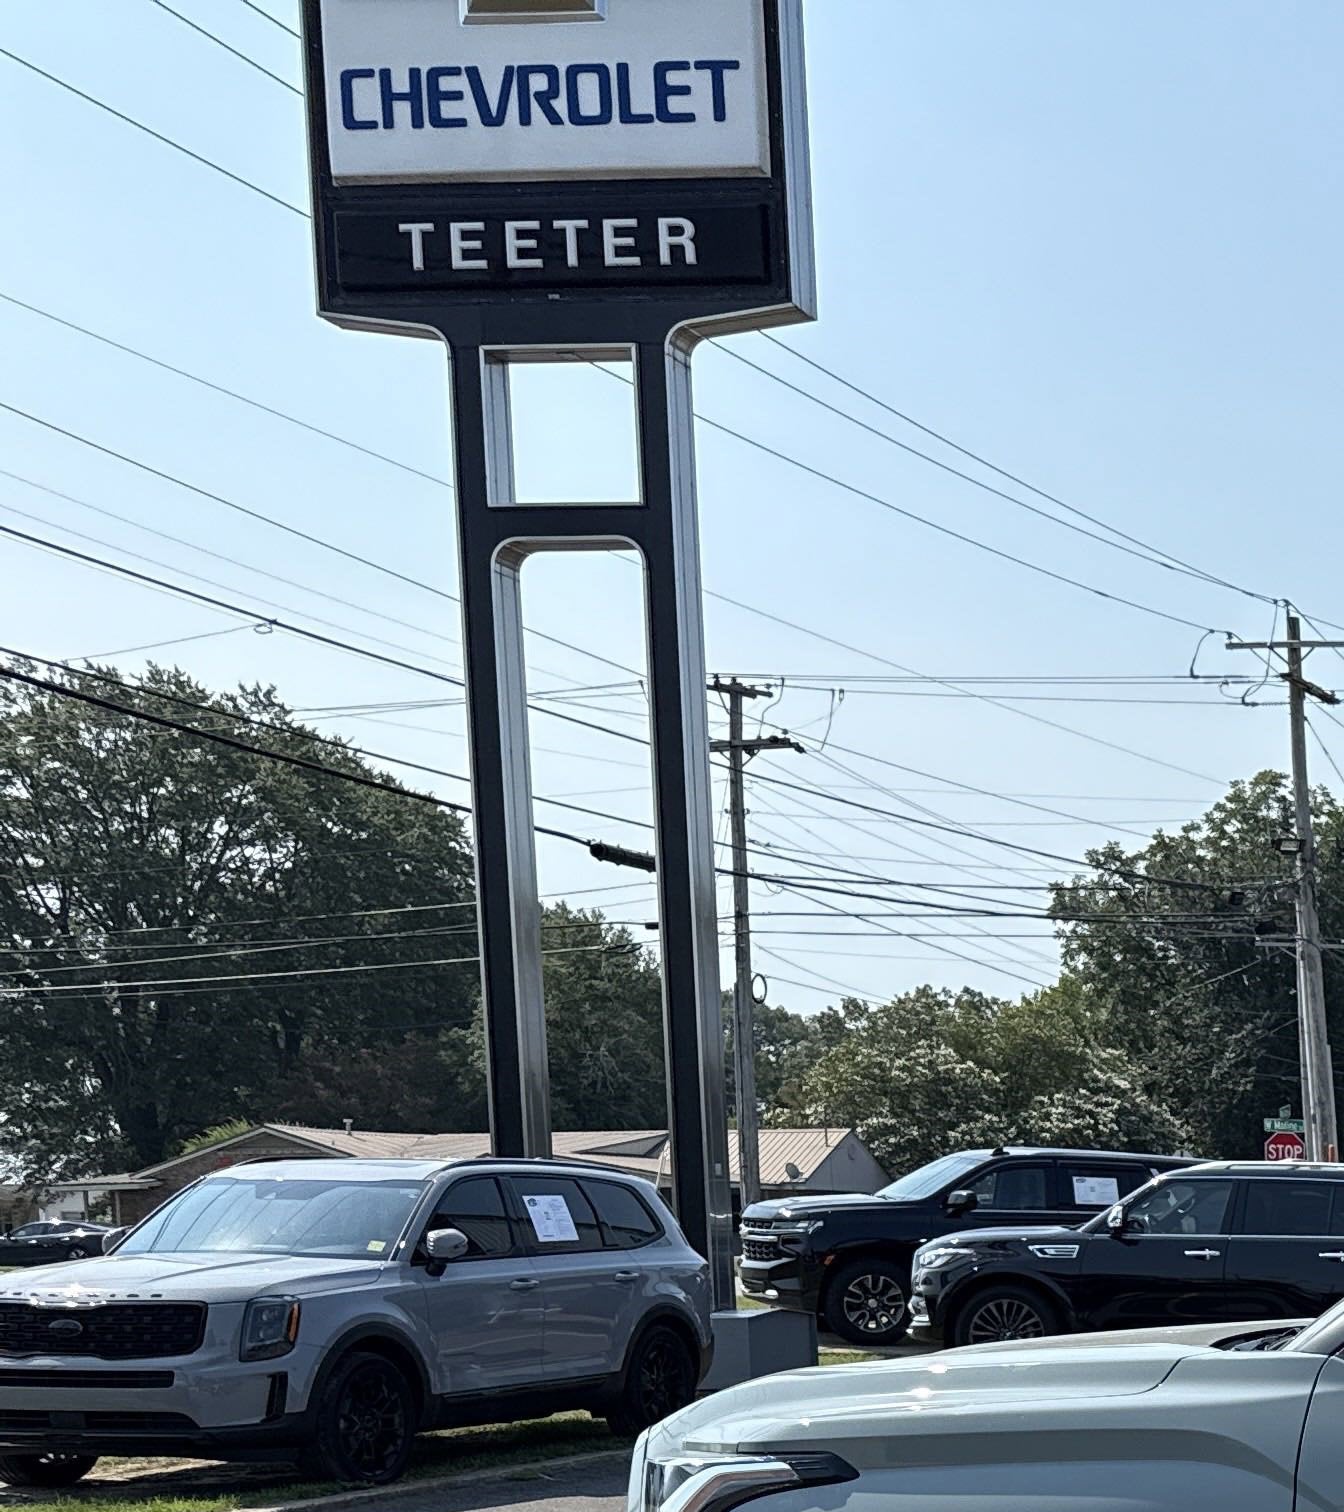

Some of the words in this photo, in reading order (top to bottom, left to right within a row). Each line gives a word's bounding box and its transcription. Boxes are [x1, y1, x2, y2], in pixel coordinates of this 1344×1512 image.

[340, 60, 740, 130] CHEVROLET
[398, 217, 698, 271] TEETER
[1268, 1144, 1303, 1159] STOP
